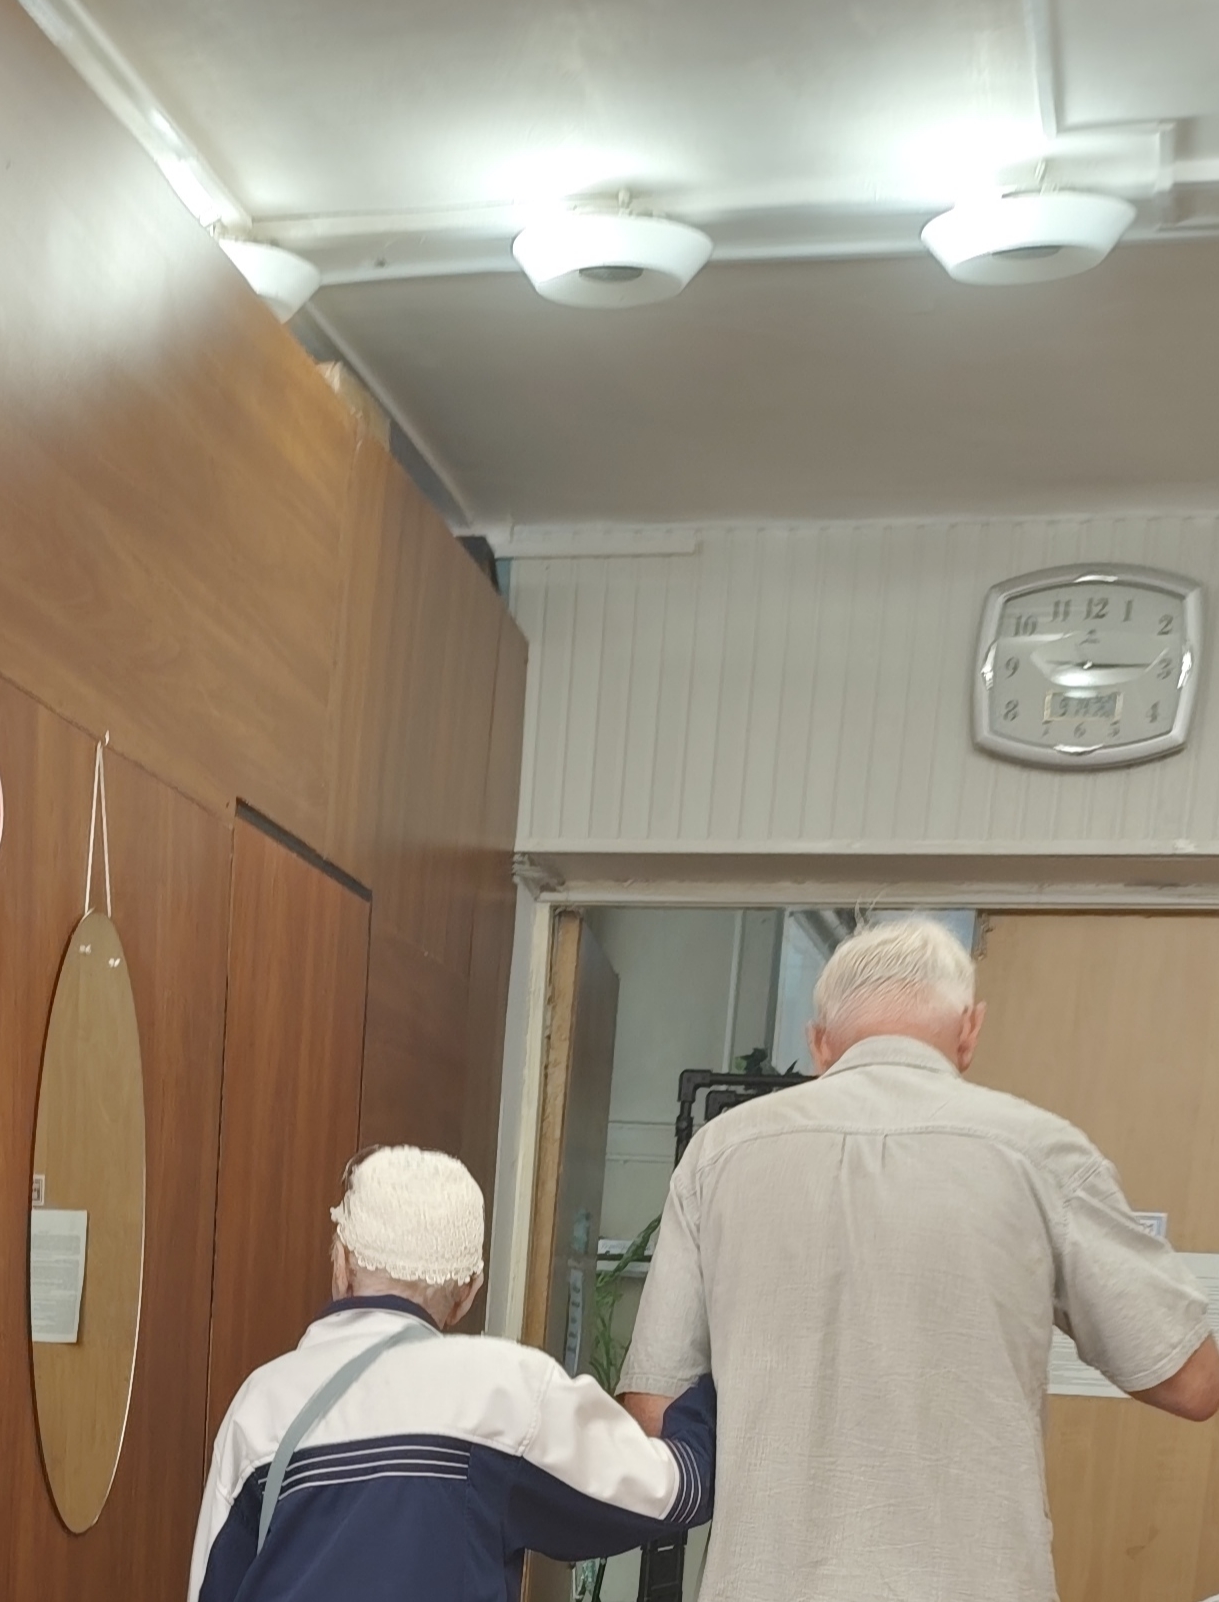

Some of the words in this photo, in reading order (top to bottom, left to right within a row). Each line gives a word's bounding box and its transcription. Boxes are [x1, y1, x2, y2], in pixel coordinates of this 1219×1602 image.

[1051, 600, 1072, 621] 11
[1085, 597, 1109, 618] 12
[1123, 599, 1134, 621] 1
[1013, 614, 1038, 636] 10
[1158, 614, 1174, 635] 2
[1005, 656, 1019, 678] 9
[1156, 657, 1172, 679] 3
[1003, 700, 1019, 721] 8
[1146, 702, 1159, 723] 4
[1074, 722, 1086, 738] 6
